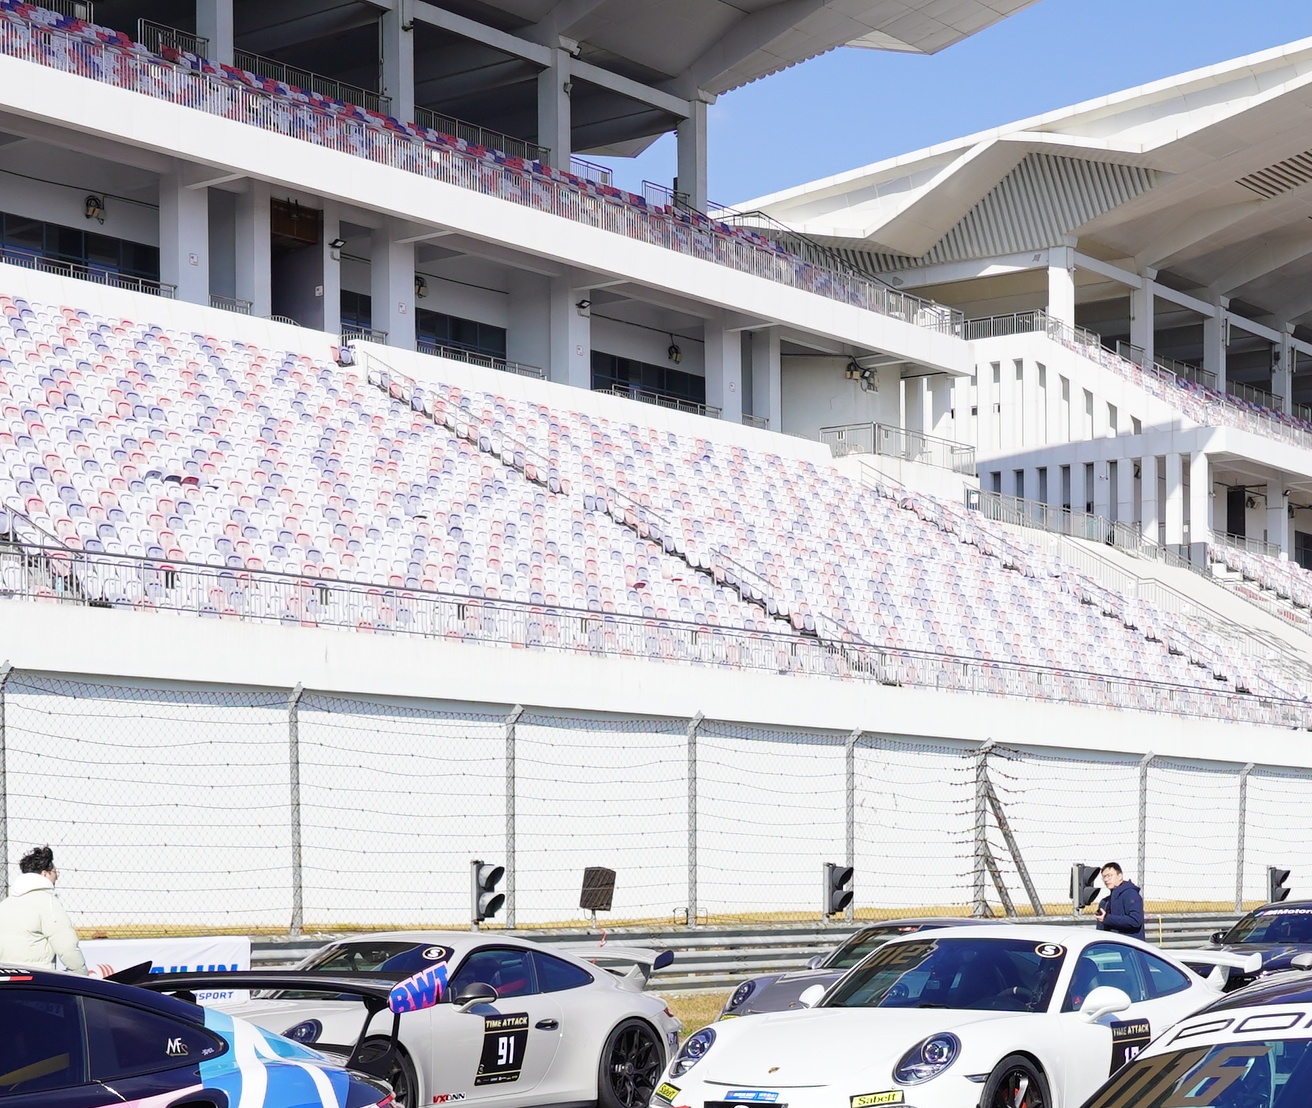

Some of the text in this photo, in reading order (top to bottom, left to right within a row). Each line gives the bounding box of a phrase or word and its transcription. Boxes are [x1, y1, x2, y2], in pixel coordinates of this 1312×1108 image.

[388, 961, 448, 1013] BWT
[485, 1016, 528, 1029] TIME ATTACK
[1127, 1023, 1150, 1034] ATTACK
[497, 1035, 515, 1066] 91
[857, 1092, 897, 1106] Sabelt
